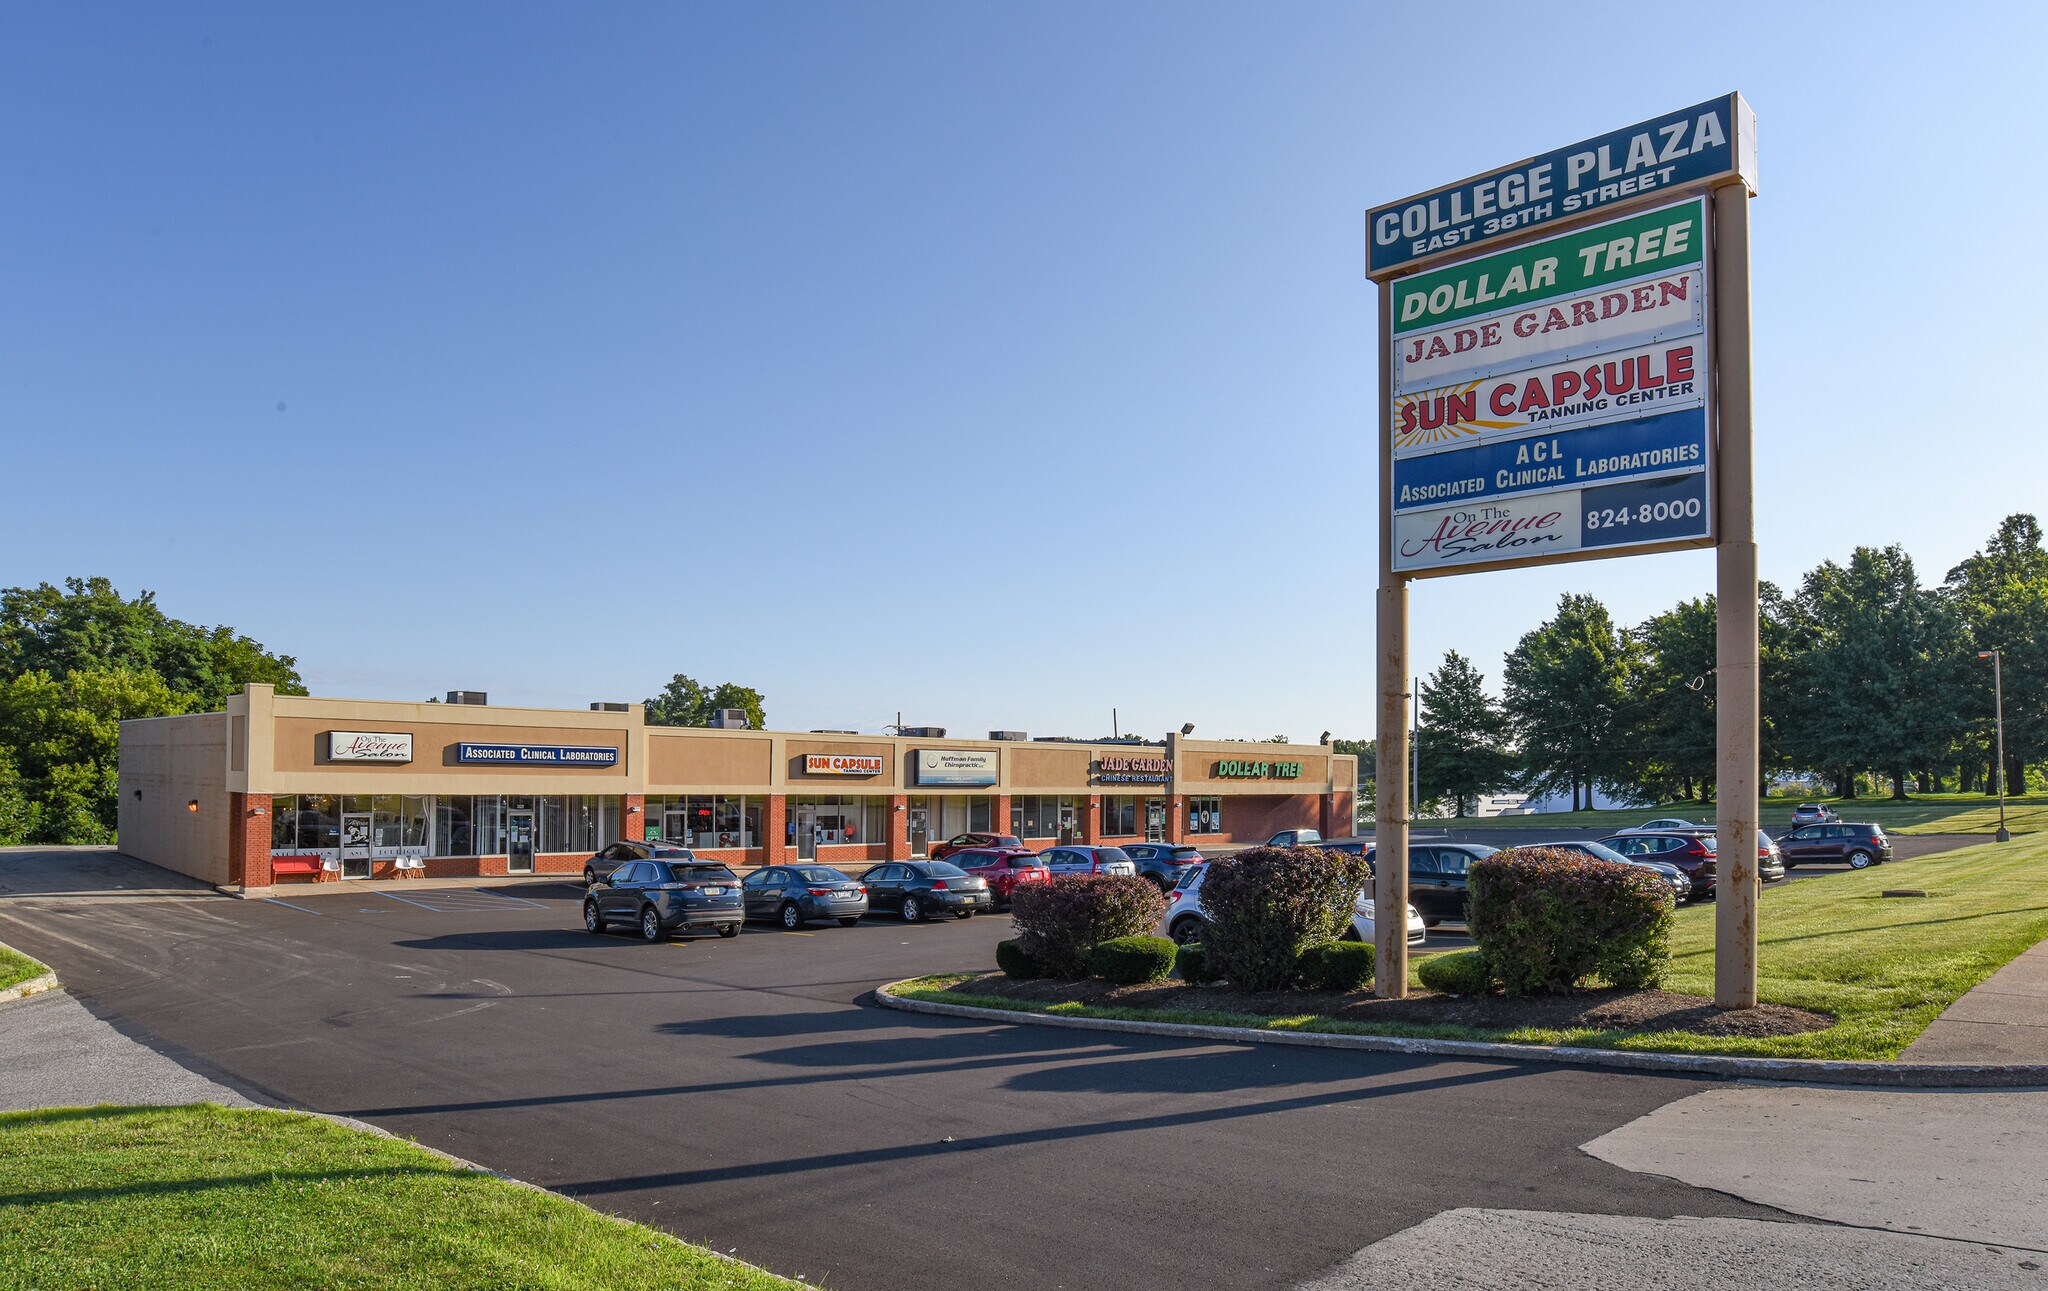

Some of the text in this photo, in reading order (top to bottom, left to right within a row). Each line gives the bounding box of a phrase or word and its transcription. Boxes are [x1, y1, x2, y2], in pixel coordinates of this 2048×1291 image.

[1375, 111, 1727, 246] COLLEGE PLAZA
[1412, 166, 1676, 256] EAST 38TH STREET
[1400, 219, 1693, 323] DOLLAR TREE
[1405, 276, 1690, 363] JADE GARDEN
[1400, 346, 1695, 435] SUN CAPSULE
[1528, 381, 1694, 423] TANNING CENTER
[1400, 443, 1700, 503] ASSOCIATED CLINICAL LABORATORIES
[1453, 507, 1511, 524] On The
[1400, 511, 1562, 557] Avenue
[1440, 532, 1563, 559] Salon
[335, 736, 408, 755] Avenue
[360, 735, 371, 743] On
[355, 749, 407, 758] Salon
[465, 746, 614, 761] ASSOCIATED CLINICAL LABORATORIES
[808, 757, 881, 769] SUN CAPSULE
[1101, 757, 1173, 772] JADE GARDEN
[1218, 760, 1303, 777] DOLLAR TREE
